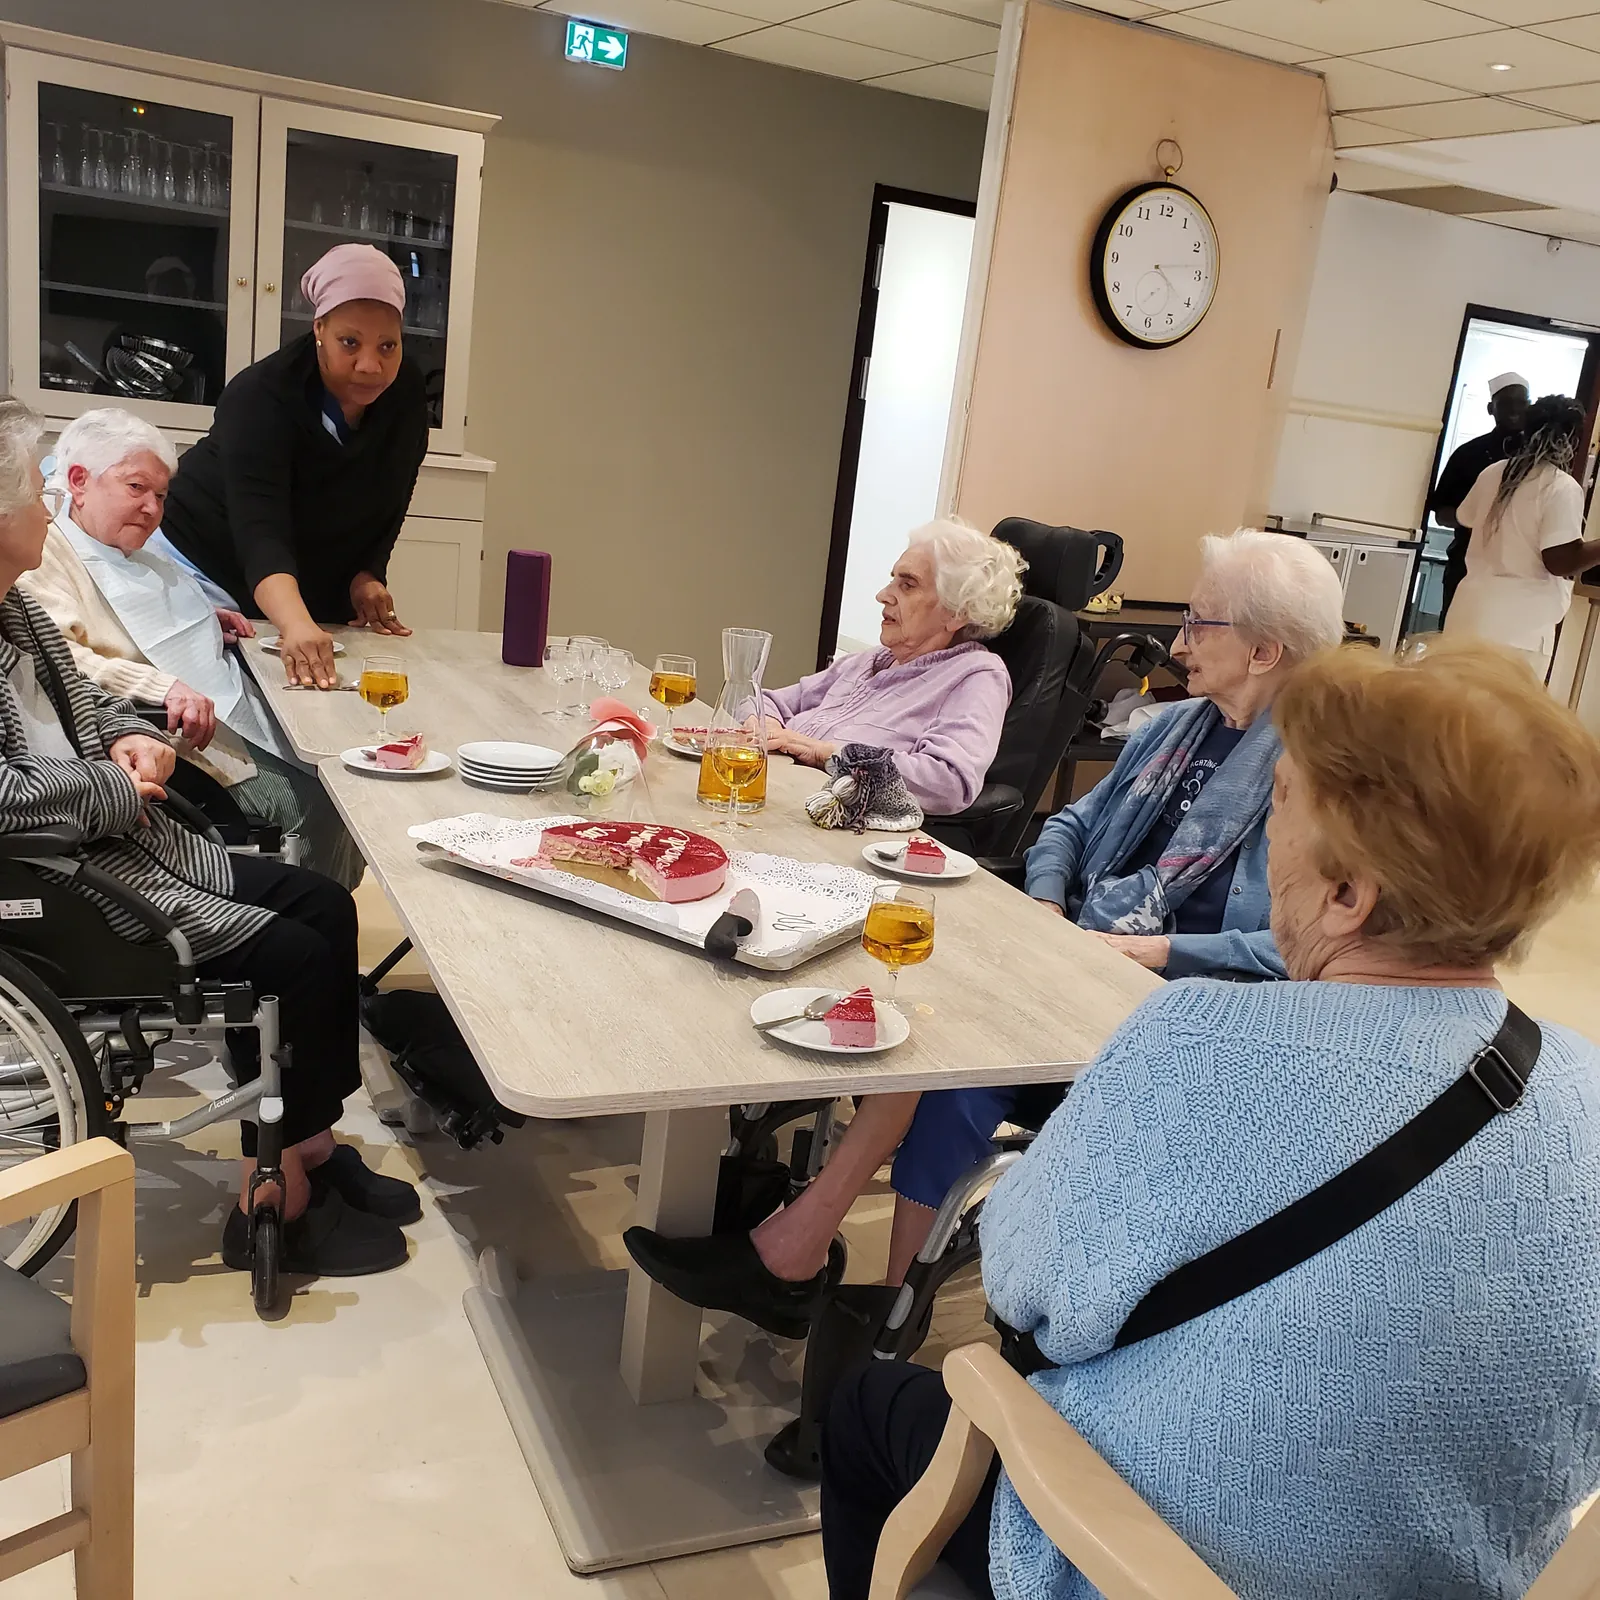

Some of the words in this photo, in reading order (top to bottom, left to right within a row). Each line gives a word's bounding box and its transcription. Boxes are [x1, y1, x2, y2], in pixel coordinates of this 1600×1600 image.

[1137, 207, 1150, 220] 11
[1159, 204, 1174, 217] 12
[1182, 218, 1188, 229] 1
[1118, 224, 1133, 237] 10
[1193, 241, 1200, 253] 2
[1112, 252, 1119, 263] 9
[1194, 270, 1201, 281] 3
[1112, 282, 1120, 293] 8
[1184, 297, 1191, 308] 4
[1126, 305, 1133, 316] 7
[1145, 317, 1151, 328] 6
[1166, 313, 1173, 324] 5
